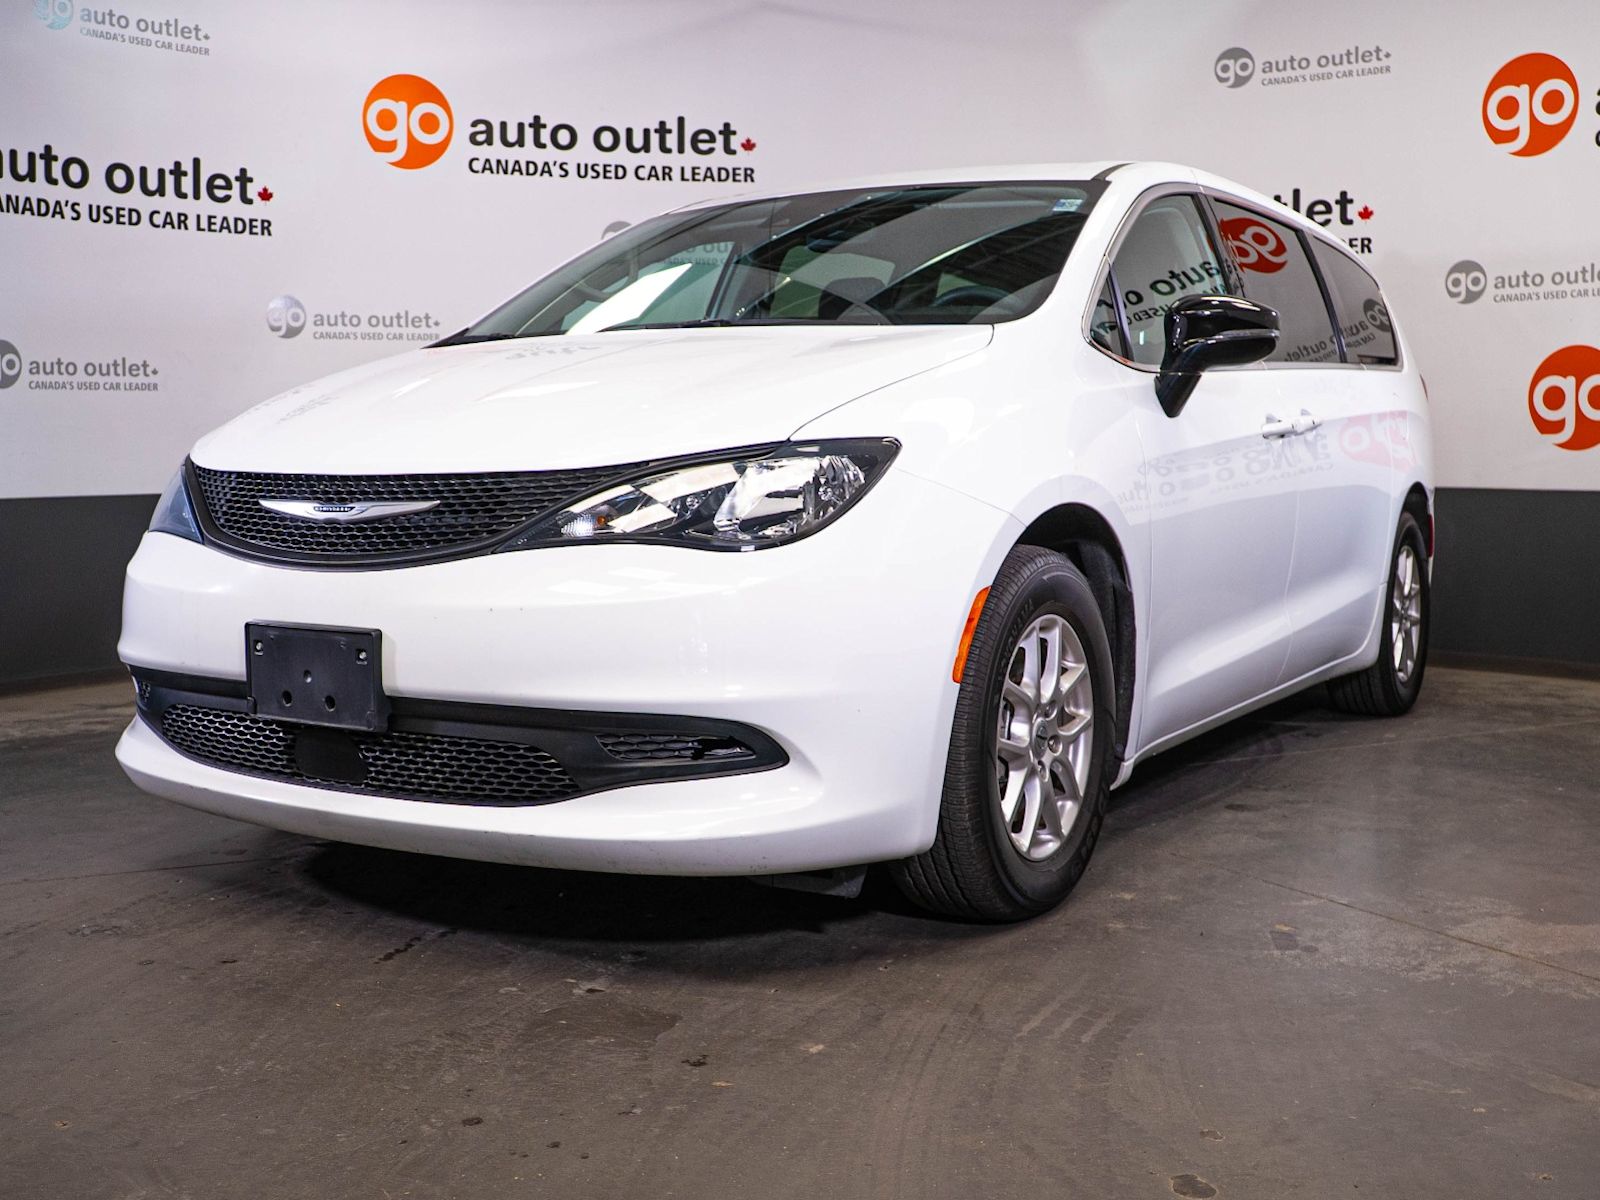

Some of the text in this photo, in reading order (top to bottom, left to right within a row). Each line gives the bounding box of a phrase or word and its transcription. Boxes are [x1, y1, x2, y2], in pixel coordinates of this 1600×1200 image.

[80, 7, 130, 29] auto
[136, 18, 203, 41] outlet
[80, 27, 210, 56] CANADA'S USED CAR LEADER
[1216, 45, 1384, 87] go auto outlet
[1261, 65, 1392, 87] CANADA'S USED CAR LEADER
[1487, 78, 1575, 154] go
[366, 98, 737, 164] go auto outlet
[104, 157, 254, 205] outlet
[467, 157, 756, 184] CANADA'S USED CAR LEADER
[88, 203, 142, 227] USED
[149, 209, 189, 231] CAR
[195, 213, 273, 237] LEADER
[1447, 271, 1487, 302] go
[1493, 270, 1545, 290] auto
[1493, 291, 1541, 304] CANADA'S
[1543, 289, 1568, 301] USED
[1570, 287, 1590, 299] CAR
[313, 311, 362, 328] auto
[367, 310, 432, 329] outlet
[313, 331, 441, 342] CANADA'S USED CAR LEADER
[28, 357, 78, 376] auto
[84, 356, 150, 378] outlet
[28, 380, 159, 392] CANADA'S USED CAR LEADER
